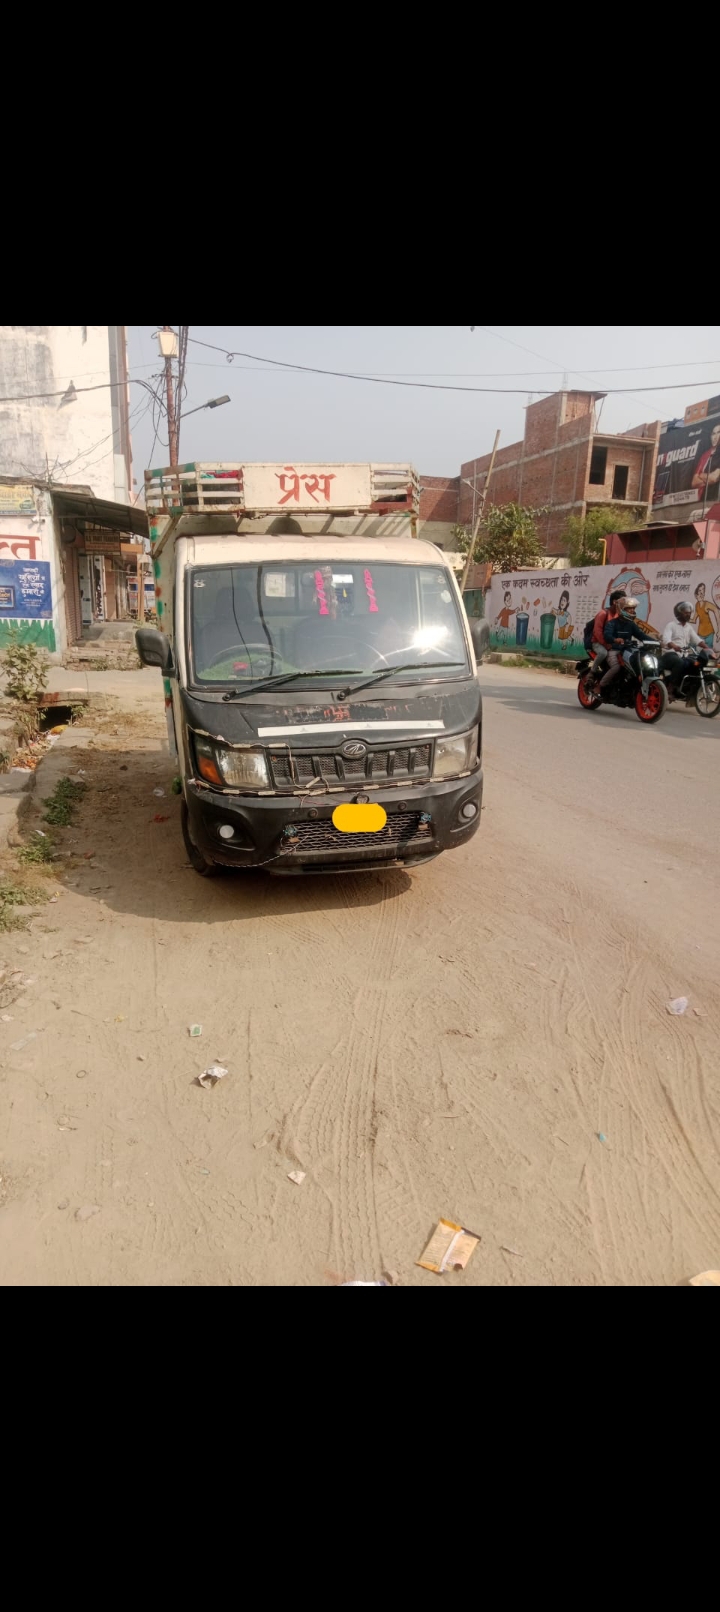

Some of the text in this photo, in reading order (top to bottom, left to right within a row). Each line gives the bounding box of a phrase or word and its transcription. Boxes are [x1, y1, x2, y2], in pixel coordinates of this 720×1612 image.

[274, 466, 337, 505] प्रेस
[501, 580, 511, 590] एक
[512, 579, 529, 590] कदम
[561, 572, 572, 588] की
[573, 570, 590, 587] ओर
